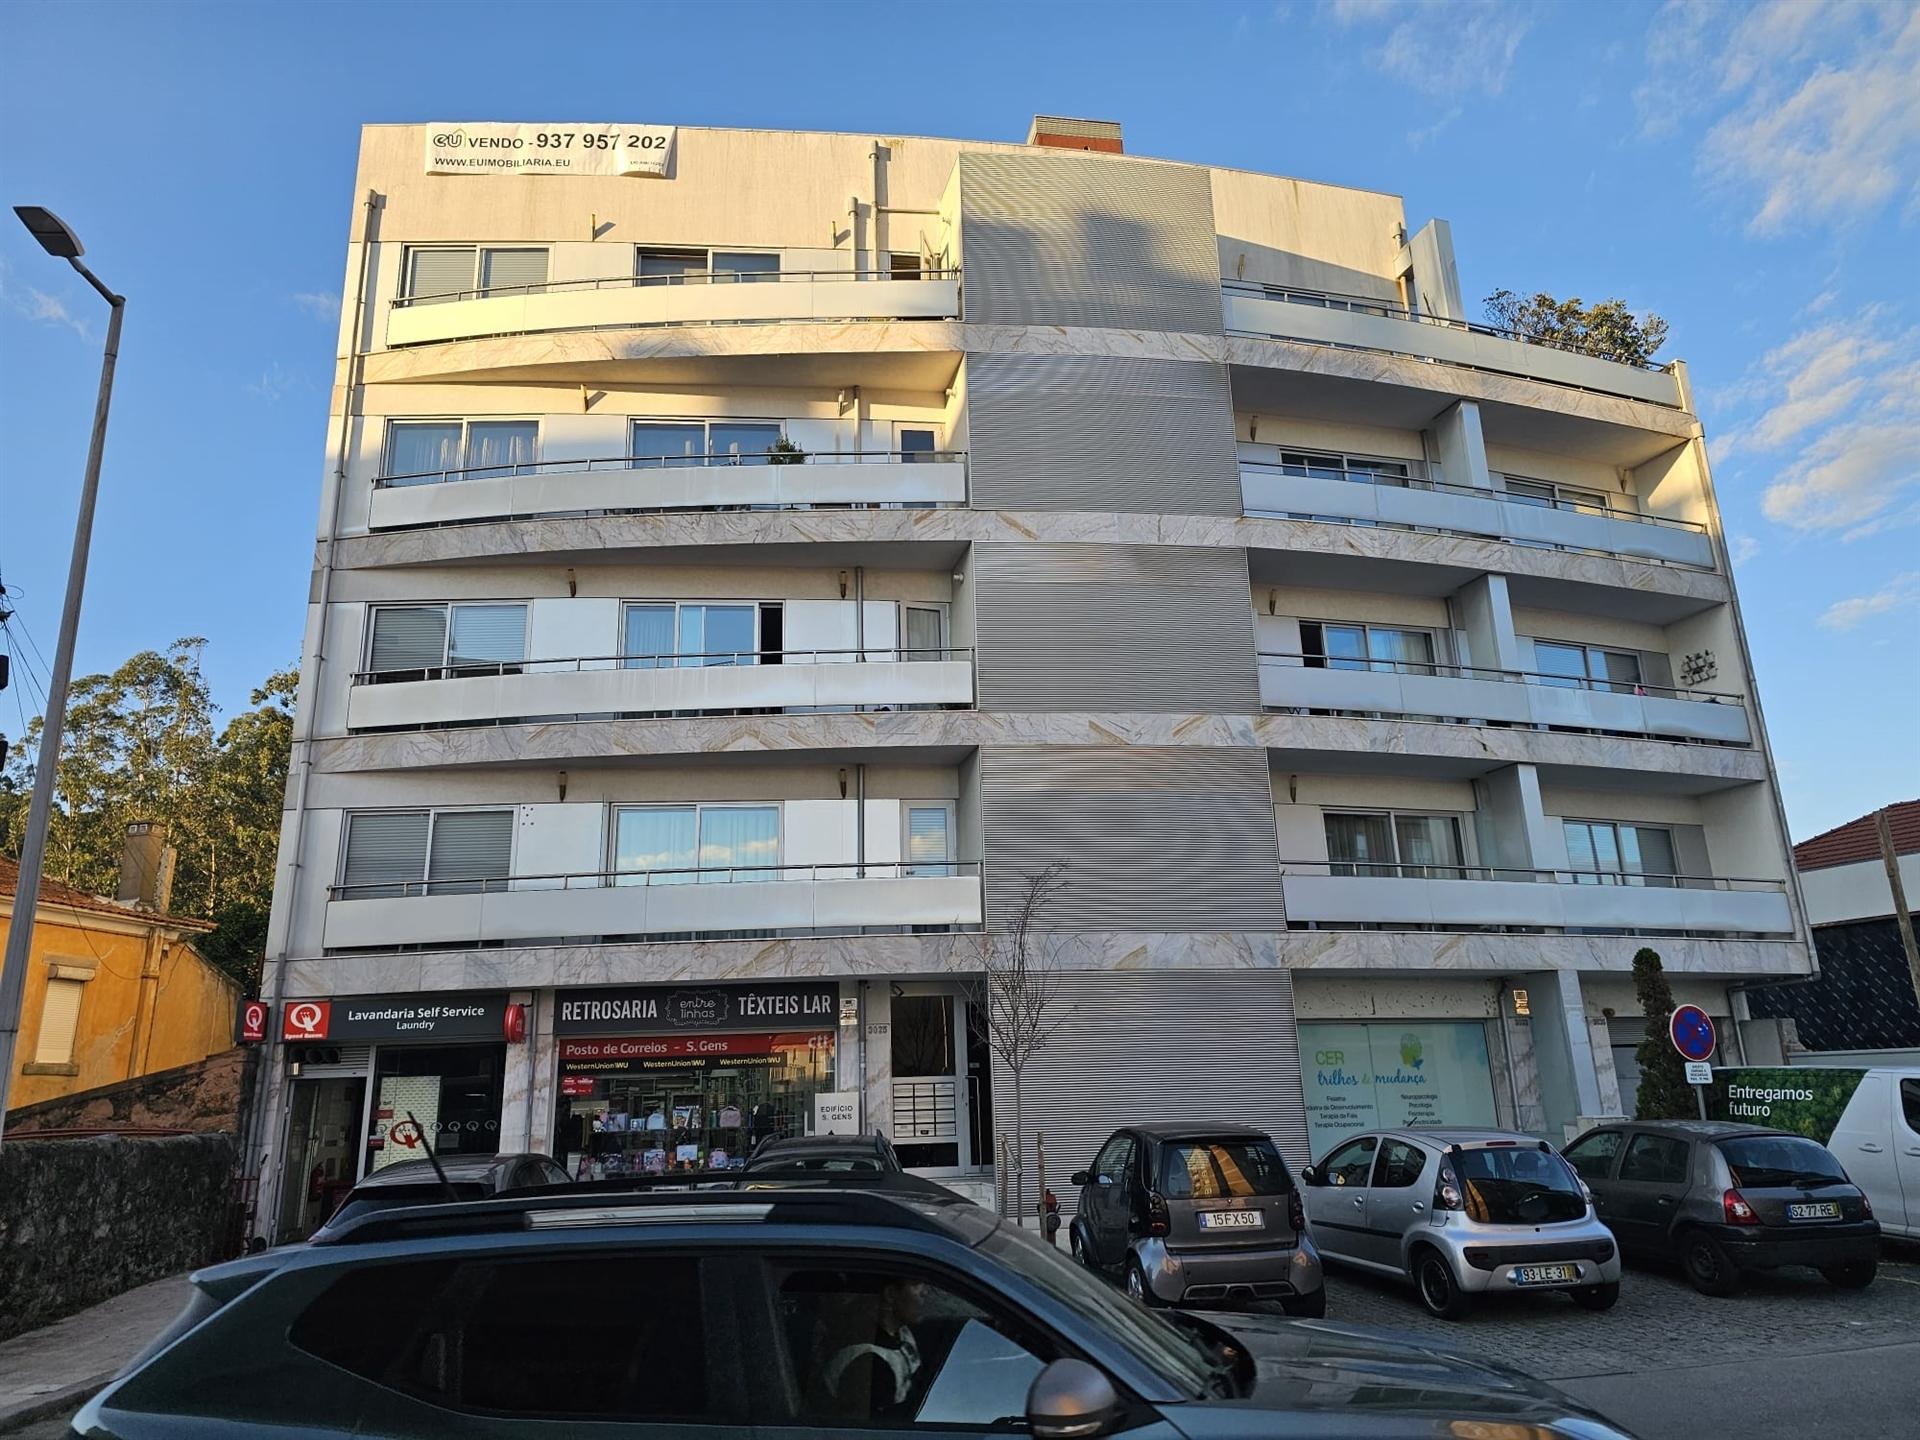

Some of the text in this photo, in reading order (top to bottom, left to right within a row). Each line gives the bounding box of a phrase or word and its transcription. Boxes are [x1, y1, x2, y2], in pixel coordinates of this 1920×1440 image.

[469, 137, 524, 149] VENDO
[536, 133, 575, 148] 937
[583, 133, 620, 150] 957
[627, 135, 666, 149] 202
[435, 157, 570, 168] WWW.EUIMOBILIARIA.EU
[680, 995, 716, 1009] entre
[738, 992, 832, 1016] TÊXTEIS LAR
[348, 1006, 485, 1021] Lavandaria Self Service
[562, 999, 658, 1021] RETROSARIA
[681, 1007, 715, 1019] linhas
[396, 1020, 435, 1031] Laundry
[566, 1044, 599, 1056] Posto
[603, 1043, 618, 1054] de
[620, 1041, 668, 1054] Correios
[686, 1041, 697, 1052] S.
[699, 1041, 728, 1052] Gens
[1315, 1050, 1345, 1065] CER
[1317, 1068, 1359, 1086] trilhos
[1375, 1068, 1426, 1086] mudança
[1728, 1084, 1814, 1103] Entregamos
[821, 1104, 853, 1112] EDIFÍCIO
[1728, 1101, 1771, 1117] futuro
[832, 1113, 852, 1121] GENS
